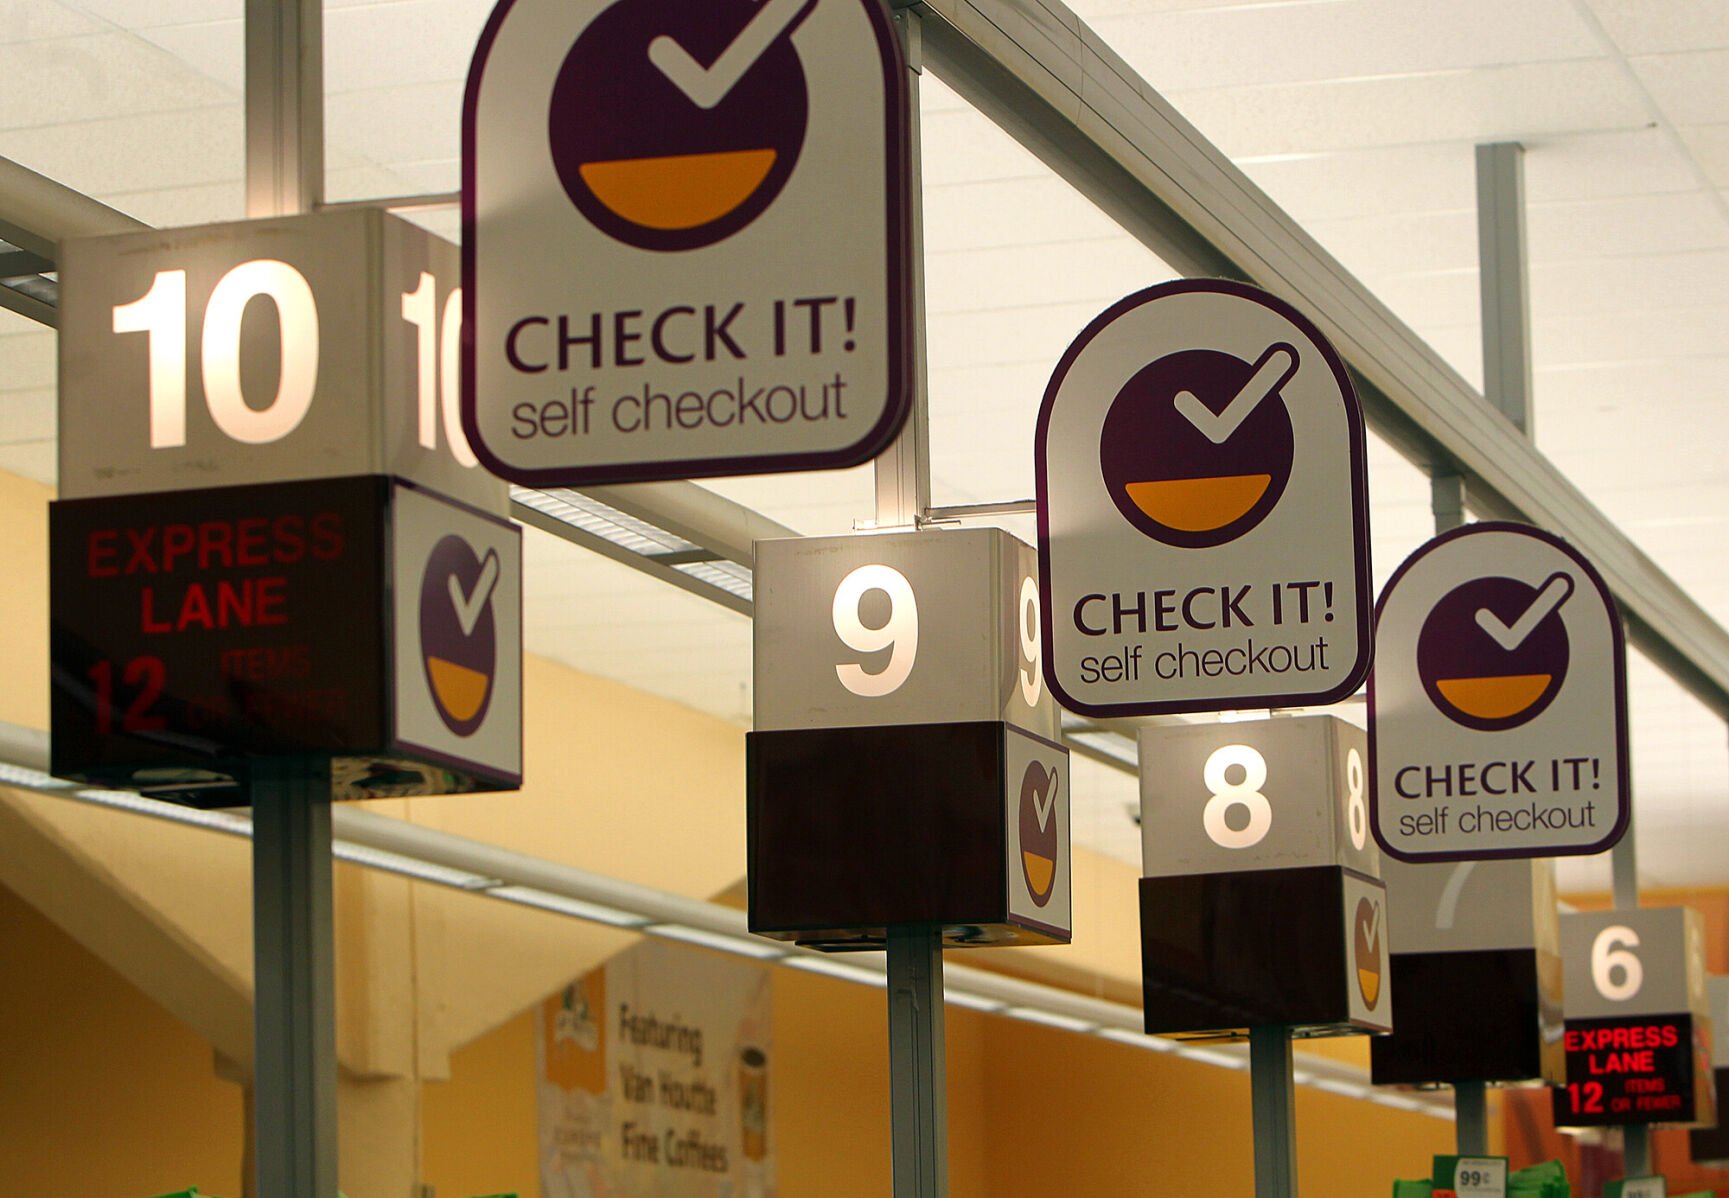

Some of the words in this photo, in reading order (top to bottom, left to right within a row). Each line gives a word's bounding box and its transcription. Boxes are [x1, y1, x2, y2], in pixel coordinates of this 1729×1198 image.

[113, 259, 319, 449] 10
[505, 303, 747, 373] CHECK
[774, 296, 856, 357] IT!
[511, 385, 597, 440] self
[612, 373, 848, 433] checkout
[87, 511, 347, 578] EXPRESS
[140, 577, 288, 634] LANE
[832, 563, 919, 697] 9
[1073, 585, 1255, 636] CHECK
[1272, 580, 1335, 625] IT!
[1019, 576, 1042, 707] 9
[1080, 645, 1143, 684] self
[1155, 637, 1330, 679] checkout
[87, 655, 167, 735] 12
[1203, 744, 1272, 849] 8
[1347, 748, 1367, 851] 8
[1394, 760, 1537, 799] CHECK
[1552, 758, 1601, 792] IT!
[1400, 806, 1449, 836] self
[1459, 801, 1596, 833] checkout
[1591, 925, 1644, 1001] 6
[619, 1003, 703, 1067] Featuring
[1564, 1025, 1678, 1051] EXPRESS
[1589, 1051, 1655, 1074] LANE
[619, 1062, 655, 1104] Van
[1567, 1082, 1604, 1114] 12
[622, 1121, 659, 1164] Fine
[665, 1128, 729, 1173] Coffees
